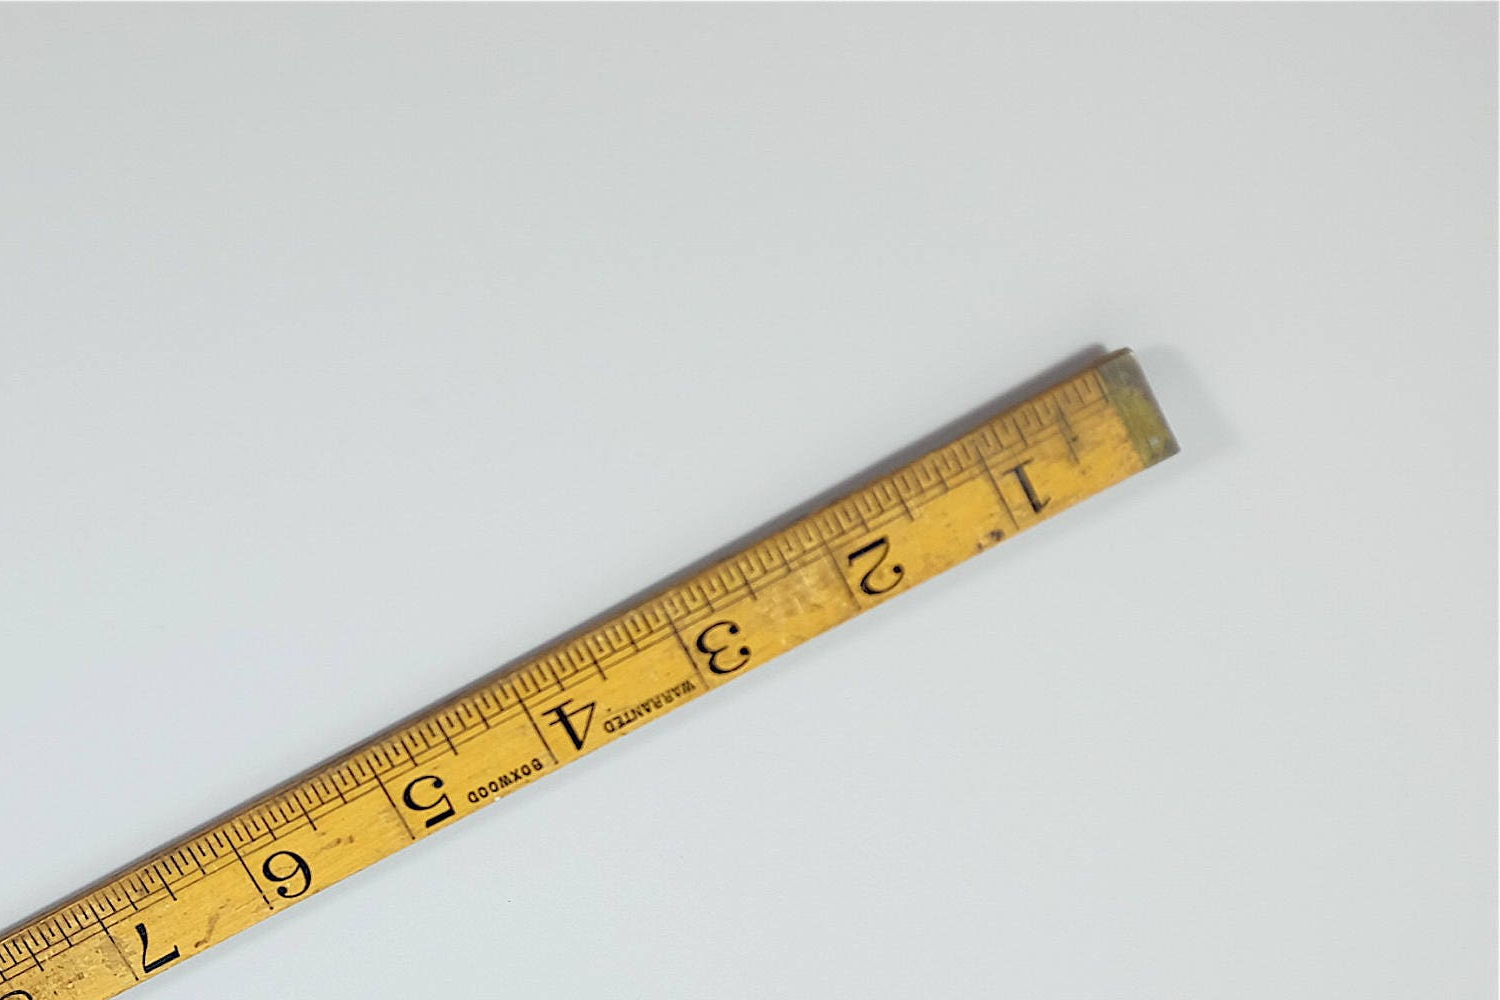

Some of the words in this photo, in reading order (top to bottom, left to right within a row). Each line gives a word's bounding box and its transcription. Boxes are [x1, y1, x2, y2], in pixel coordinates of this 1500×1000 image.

[1002, 457, 1051, 514] 1
[847, 535, 904, 595] 2
[696, 620, 751, 675] 3
[541, 697, 596, 751] 4
[603, 679, 697, 734] WARRANTED
[402, 774, 456, 828] 5
[467, 757, 543, 803] BOXWOOD
[262, 850, 312, 899] 6
[135, 922, 180, 974] 7
